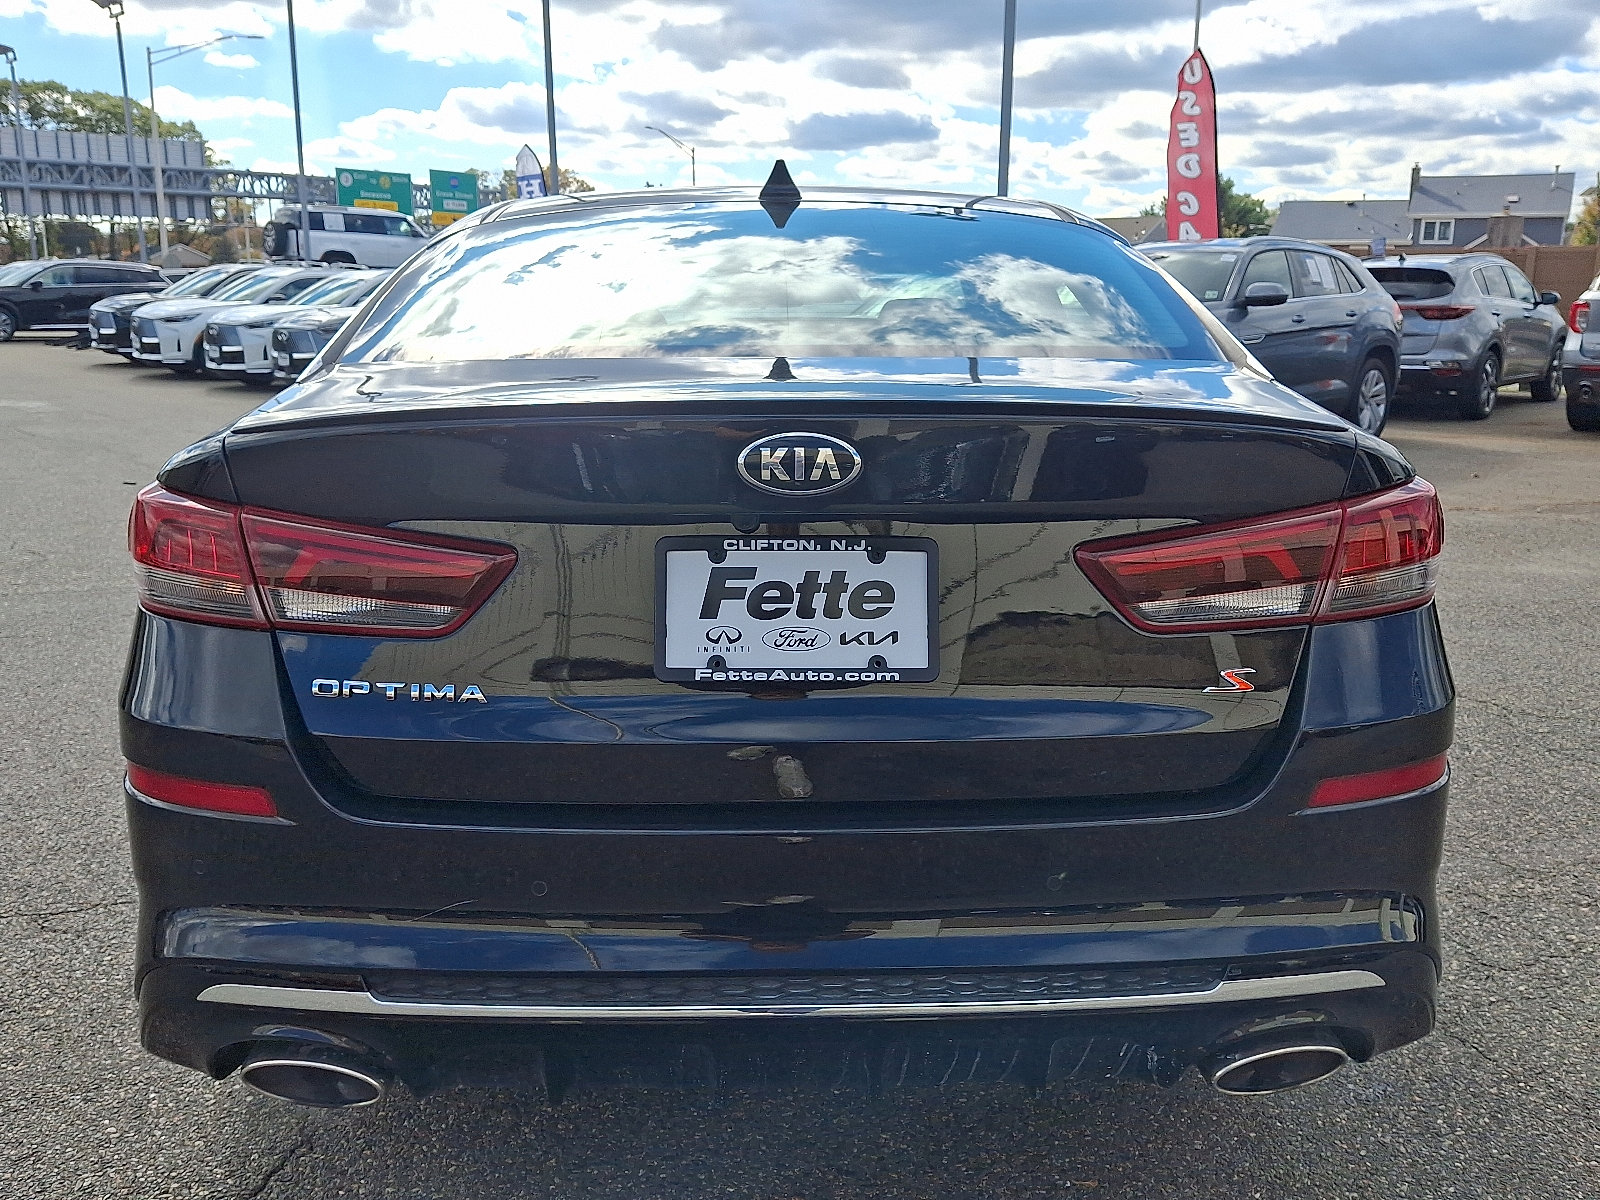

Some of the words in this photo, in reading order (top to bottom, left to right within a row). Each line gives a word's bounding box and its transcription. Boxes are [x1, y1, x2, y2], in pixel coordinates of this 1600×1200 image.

[759, 447, 842, 481] KIA
[723, 539, 821, 552] CLIFTON,
[830, 539, 872, 551] N.J.
[698, 566, 896, 621] Fette
[697, 645, 751, 653] INFINITI
[772, 627, 819, 649] Ford
[694, 668, 900, 682] FetteAuto.com
[311, 678, 488, 704] OPTIMA
